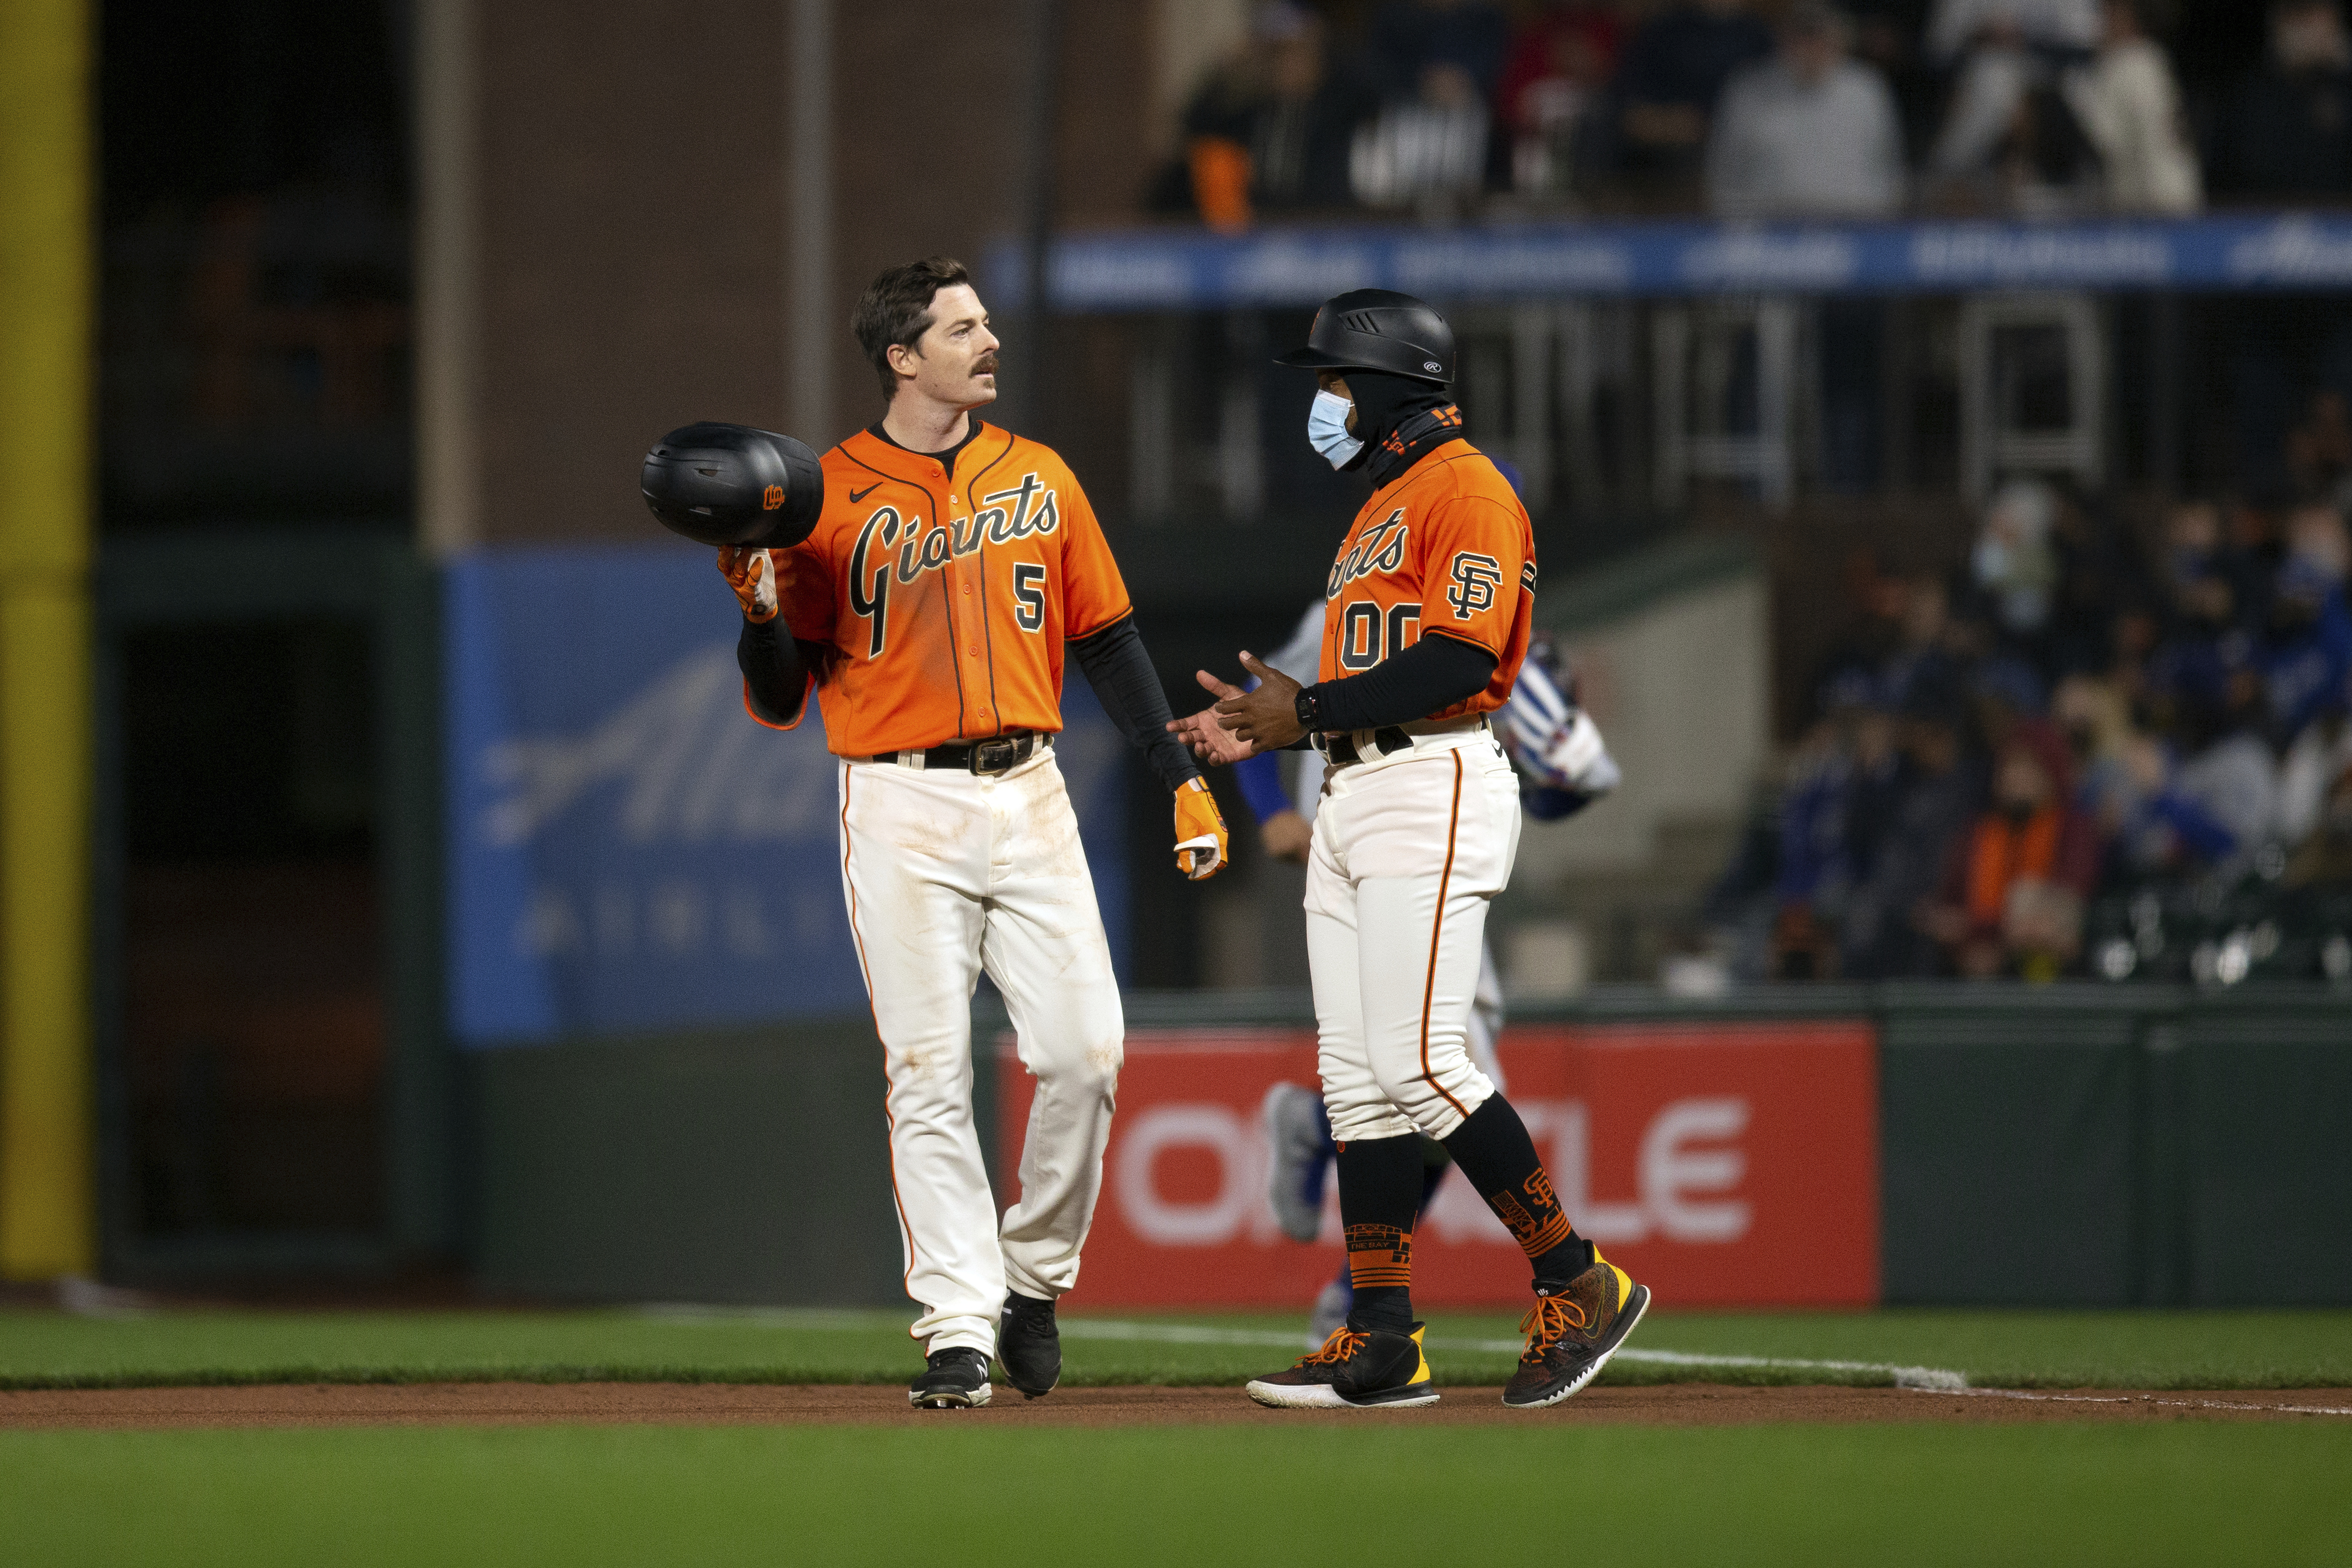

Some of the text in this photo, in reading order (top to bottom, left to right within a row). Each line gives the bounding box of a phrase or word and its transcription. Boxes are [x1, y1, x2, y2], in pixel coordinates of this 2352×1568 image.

[849, 472, 1059, 660] Giants
[1013, 562, 1046, 634] 5
[1447, 551, 1503, 621] SF
[1523, 1167, 1554, 1208] SF
